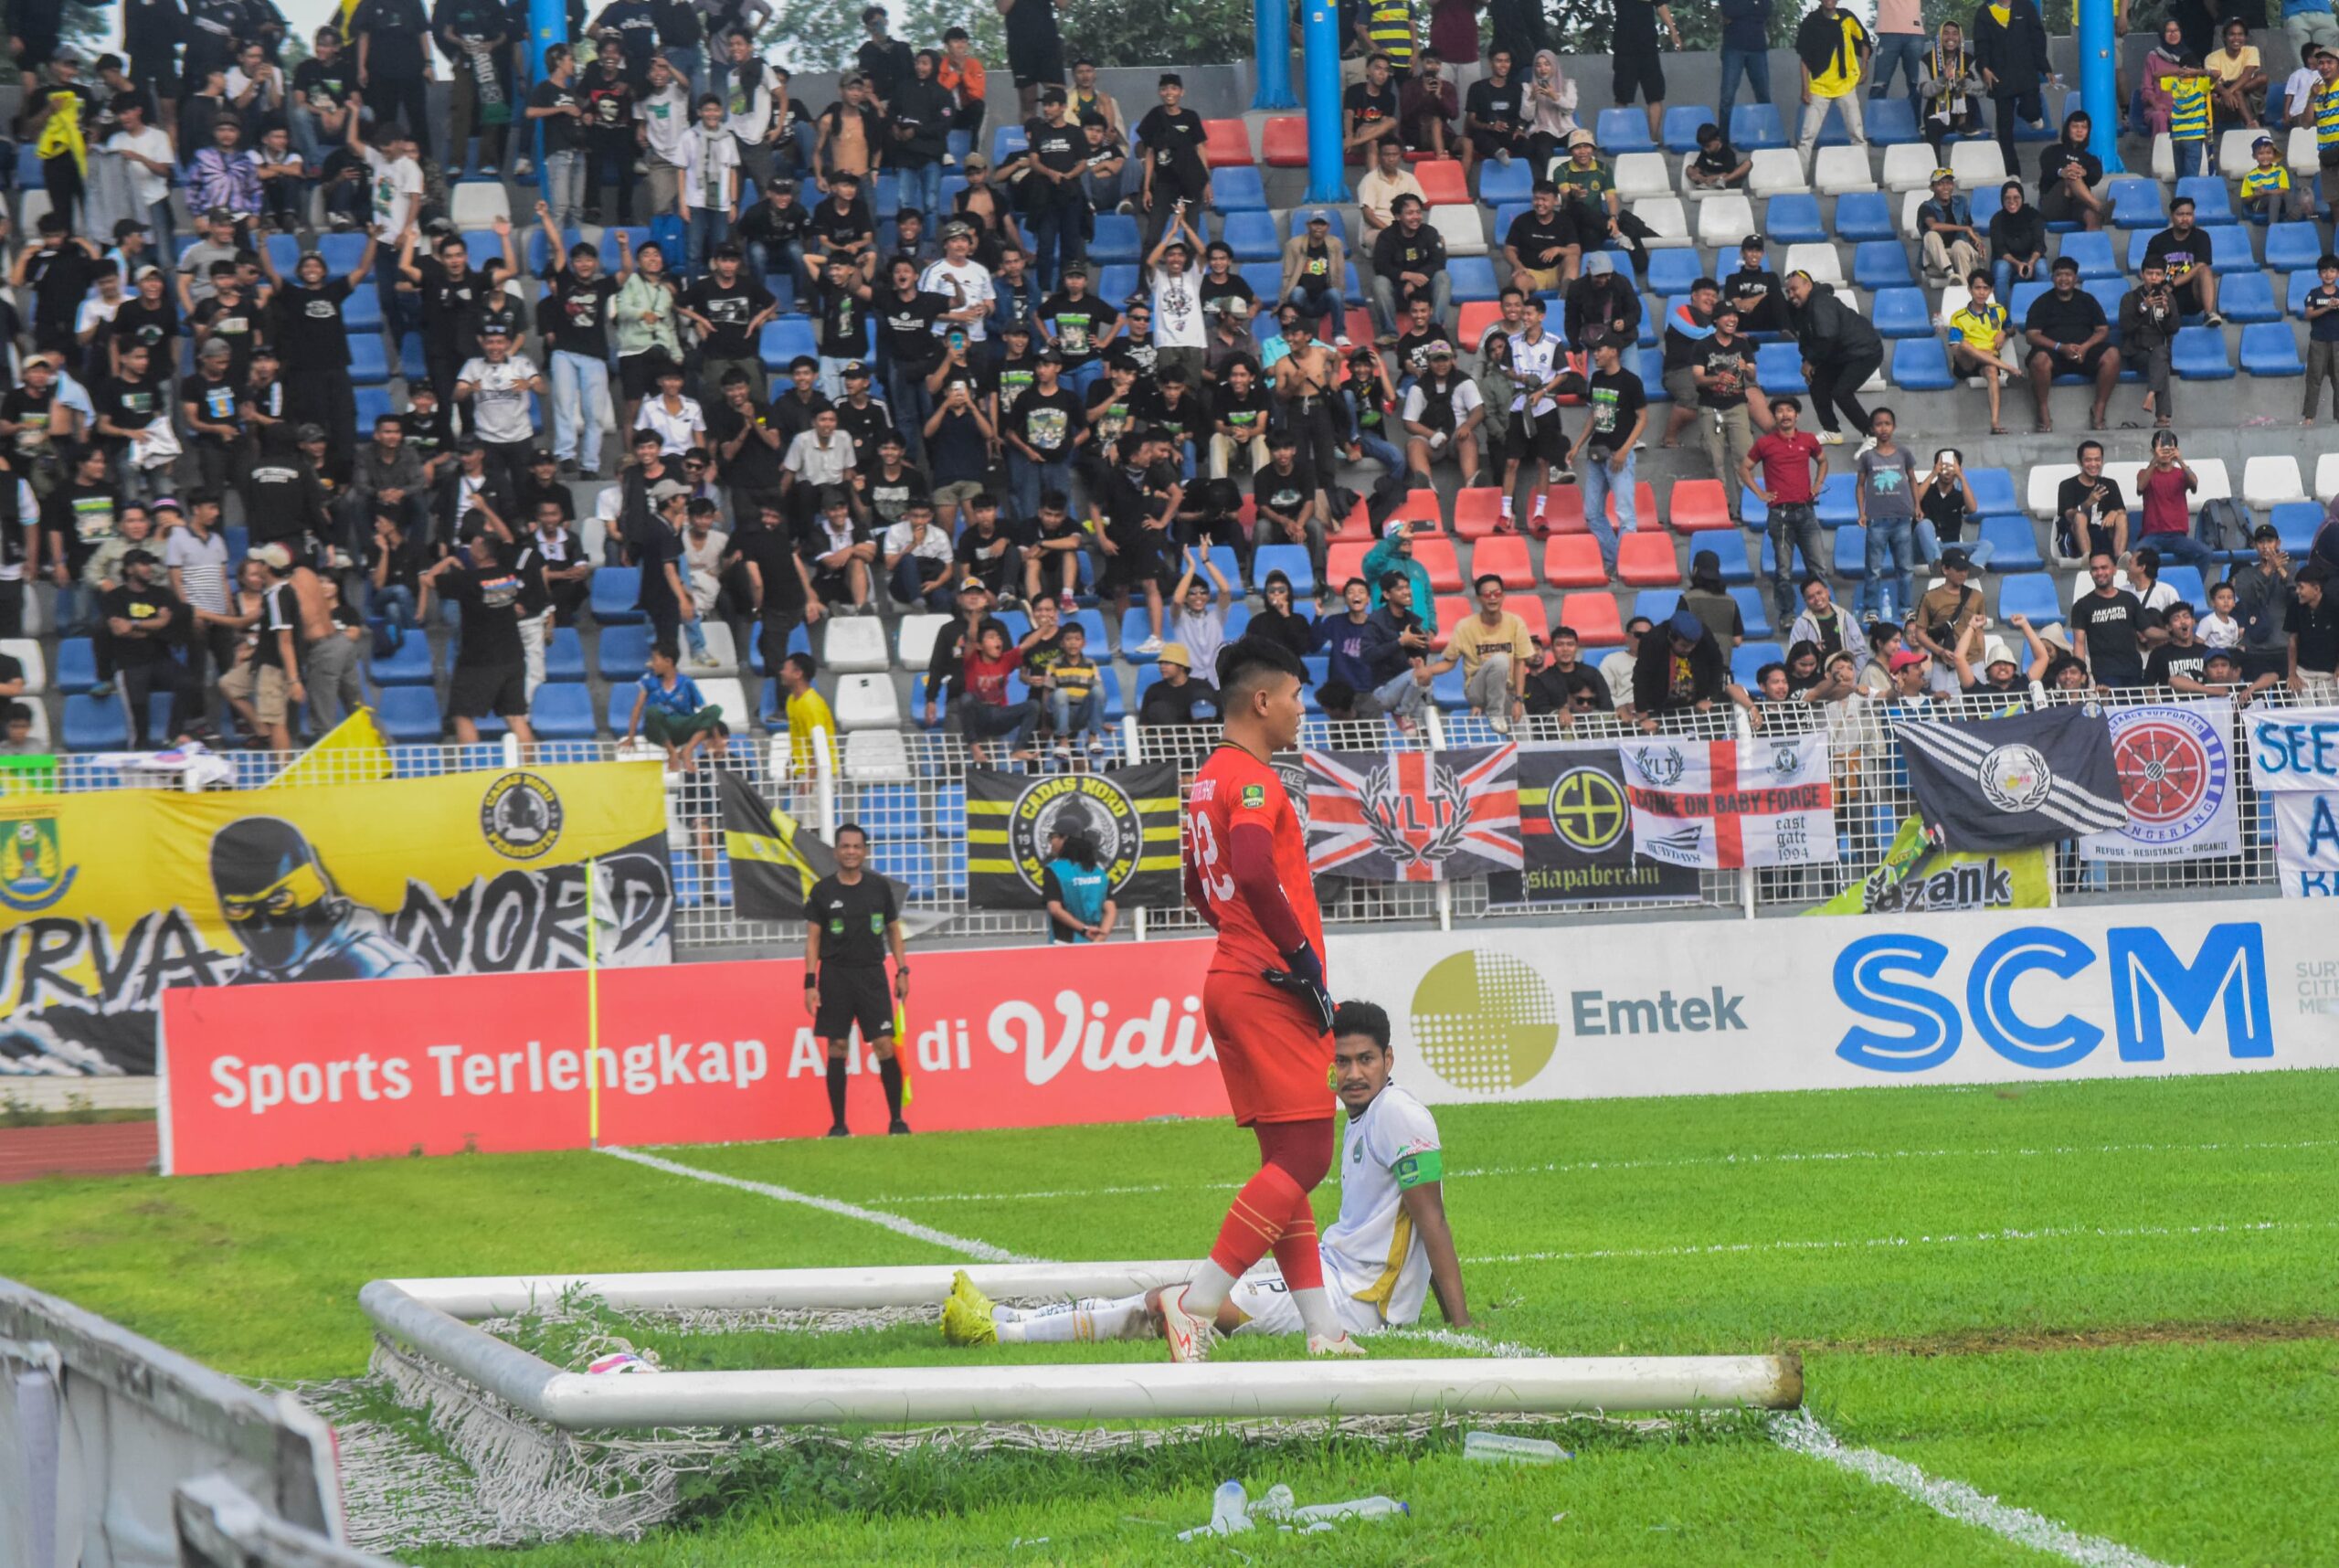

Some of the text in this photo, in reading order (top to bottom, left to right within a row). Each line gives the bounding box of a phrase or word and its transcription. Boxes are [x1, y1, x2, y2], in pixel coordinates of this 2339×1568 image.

[2091, 612, 2127, 623] STAY HIGH
[2093, 606, 2126, 617] JAKARTA
[2146, 711, 2207, 733] SUPPORTER
[1646, 757, 1676, 776] YLT
[1020, 777, 1129, 820] CADAS NORD
[1635, 785, 1822, 817] COME ON BABY FORCE
[1381, 793, 1447, 832] YLT
[2132, 801, 2214, 840] NGERANG
[1775, 815, 1806, 831] east
[1017, 833, 1032, 845] 19
[1120, 832, 1136, 845] 94
[1777, 832, 1807, 848] gate
[1778, 847, 1810, 862] 1994
[2095, 841, 2228, 857] REFUSE RESISTANCE ORGANIZE
[1528, 862, 1660, 893] siapaberani
[390, 852, 673, 975] NORD
[2296, 959, 2339, 978] SUR
[1833, 921, 2275, 1073] SCM
[1571, 985, 1749, 1036] Emtek
[210, 1053, 413, 1114] Sports
[427, 1033, 767, 1096] Terlengkap
[917, 1019, 971, 1072] di
[987, 990, 1220, 1086] Vidi
